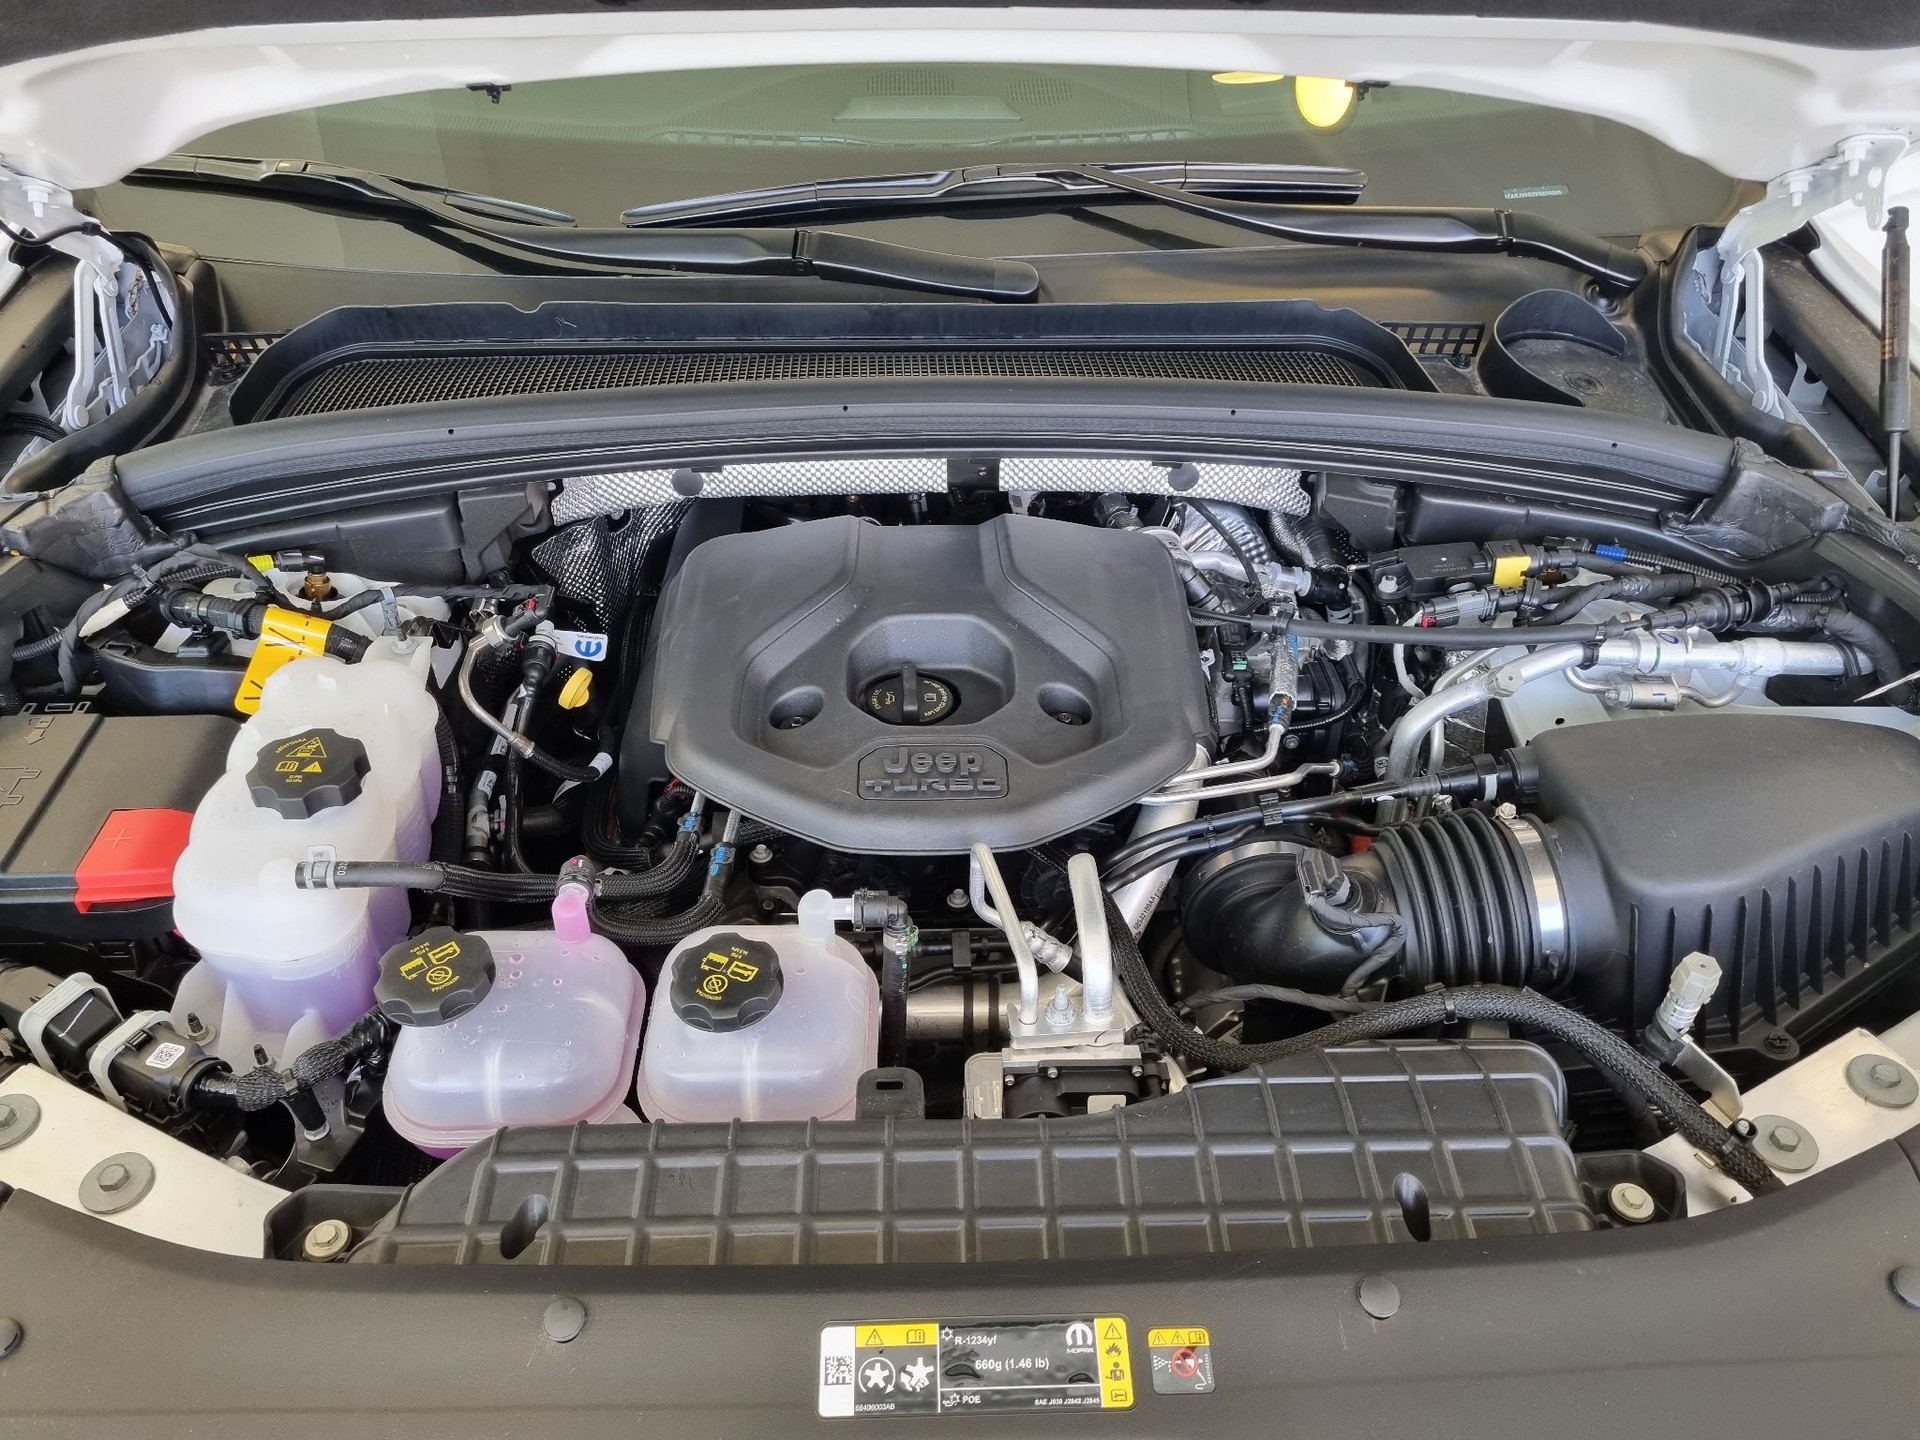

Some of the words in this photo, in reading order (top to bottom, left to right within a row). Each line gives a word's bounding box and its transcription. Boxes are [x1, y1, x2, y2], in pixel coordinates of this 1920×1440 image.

[883, 747, 983, 775] Jeep
[865, 778, 1001, 792] TURBO
[954, 1335, 998, 1346] R-1234yf
[975, 1359, 1002, 1371] 660g
[1005, 1358, 1032, 1371] (1.46
[1035, 1357, 1050, 1370] lb)
[962, 1395, 981, 1404] POE
